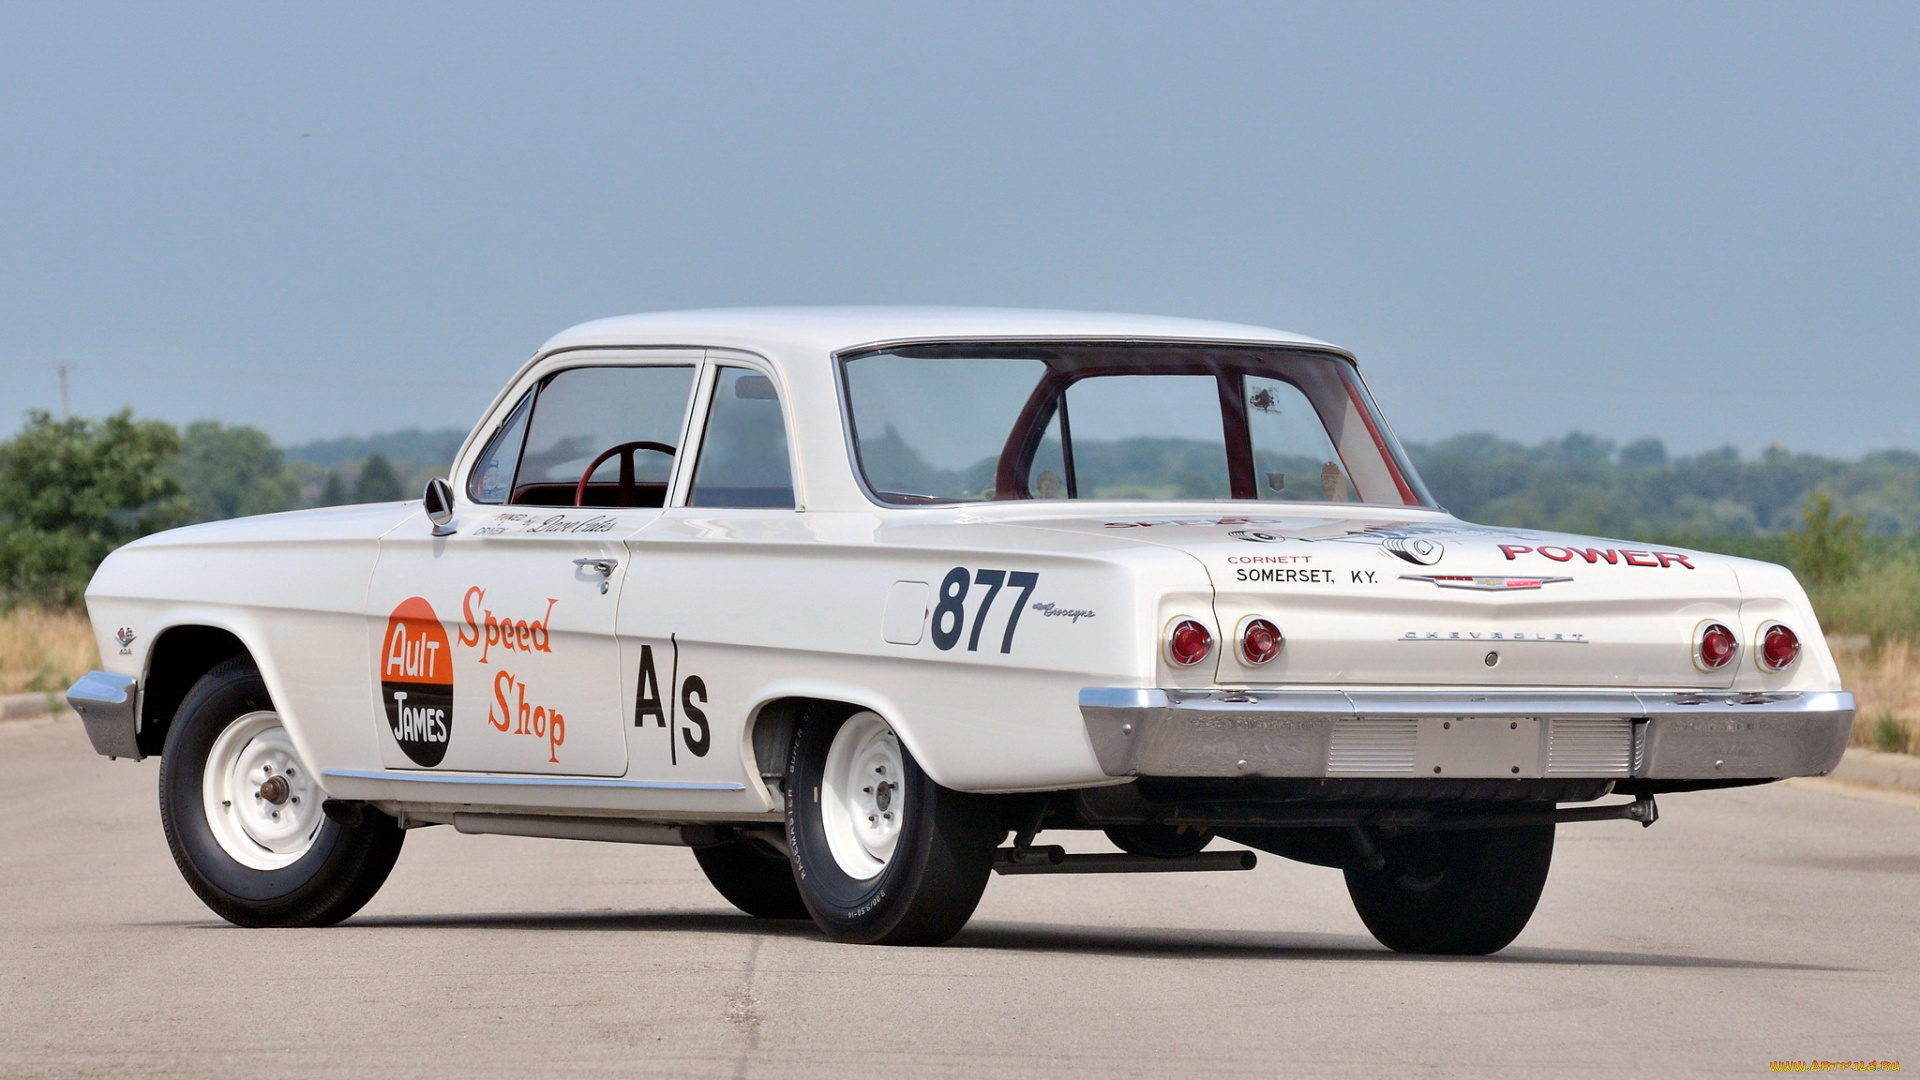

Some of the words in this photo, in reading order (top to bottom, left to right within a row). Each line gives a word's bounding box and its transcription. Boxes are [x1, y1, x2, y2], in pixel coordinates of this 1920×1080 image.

[1104, 518, 1282, 528] SPEED
[1227, 556, 1312, 564] CORNETT
[1497, 544, 1695, 570] POWER
[1236, 568, 1335, 585] SOMERSET,
[1351, 570, 1379, 584] KY.
[931, 566, 1039, 655] 877
[457, 585, 559, 664] Speed
[1404, 631, 1583, 641] CHEVROLET
[488, 670, 566, 763] Shop
